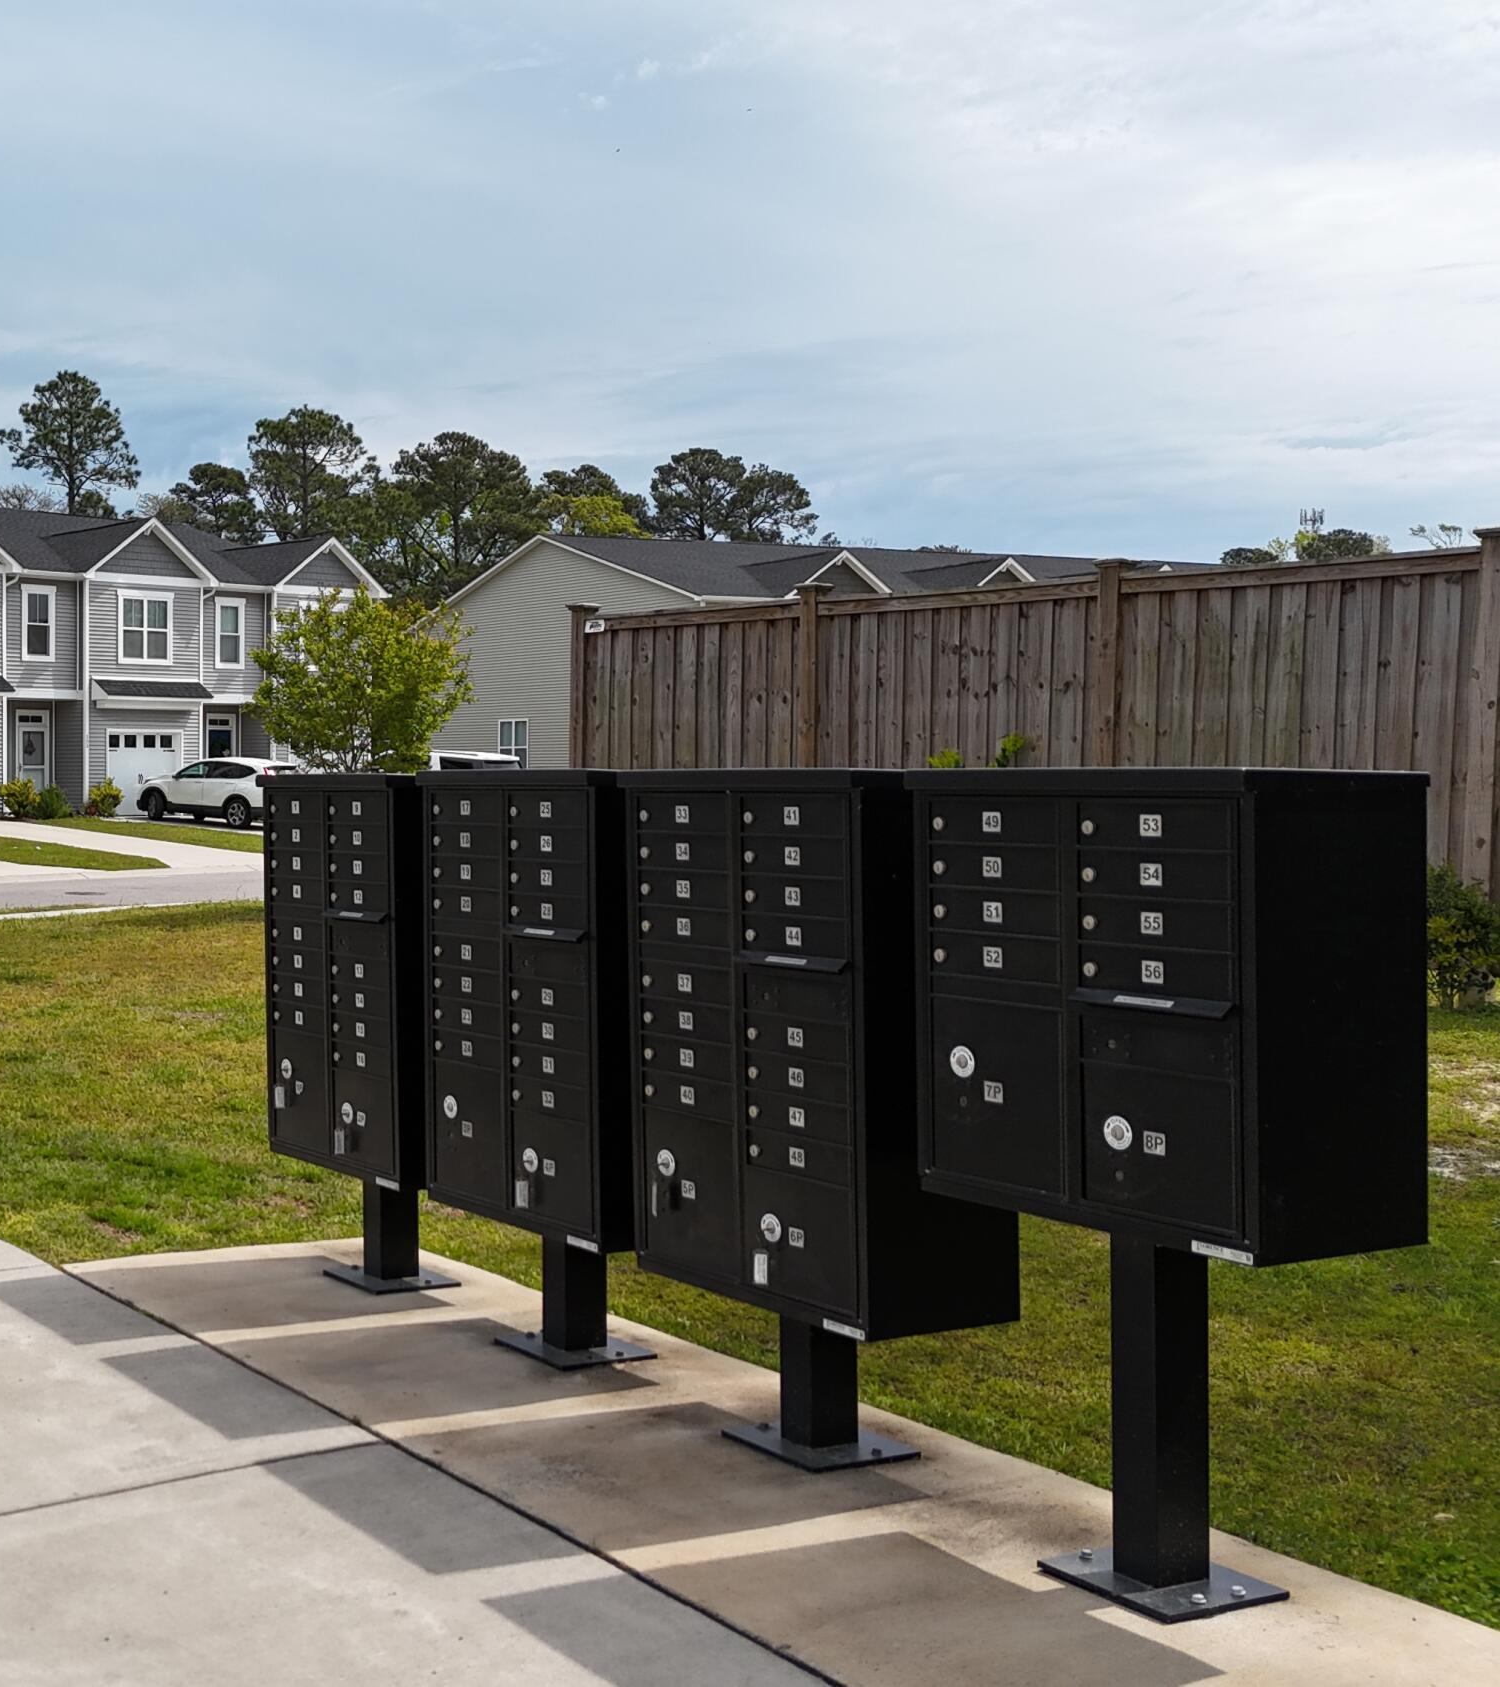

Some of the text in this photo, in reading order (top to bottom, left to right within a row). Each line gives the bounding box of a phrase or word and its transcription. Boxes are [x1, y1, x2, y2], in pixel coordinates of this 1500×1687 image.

[461, 801, 470, 813] 17
[540, 803, 551, 815] 25
[676, 807, 688, 820] 33
[785, 809, 797, 822] 41
[984, 815, 999, 828] 49
[1142, 817, 1160, 833] 53
[541, 837, 551, 849] 26
[677, 845, 689, 858] 34
[786, 849, 799, 862] 42
[461, 865, 470, 877] 19
[985, 859, 1000, 874] 50
[541, 871, 551, 883] 27
[1142, 866, 1160, 881] 54
[677, 882, 690, 895] 35
[786, 889, 799, 902] 43
[461, 898, 471, 909] 20
[542, 905, 552, 917] 28
[985, 904, 1001, 919] 51
[678, 919, 690, 933] 36
[1143, 915, 1161, 932] 55
[787, 930, 800, 942] 44
[462, 946, 471, 958] 21
[985, 949, 1000, 964] 52
[1144, 964, 1162, 980] 56
[462, 978, 471, 990] 22
[678, 975, 691, 989] 37
[542, 989, 553, 1003] 29
[680, 1013, 692, 1026] 38
[789, 1030, 802, 1043] 45
[681, 1050, 693, 1064] 39
[543, 1058, 553, 1071] 31
[790, 1070, 803, 1084] 46
[681, 1088, 693, 1102] 40
[985, 1084, 1002, 1099] 7P
[790, 1109, 803, 1122] 47
[1144, 1134, 1164, 1151] 8P
[790, 1150, 803, 1164] 48
[682, 1181, 695, 1195] 5P
[790, 1229, 803, 1243] 6P
